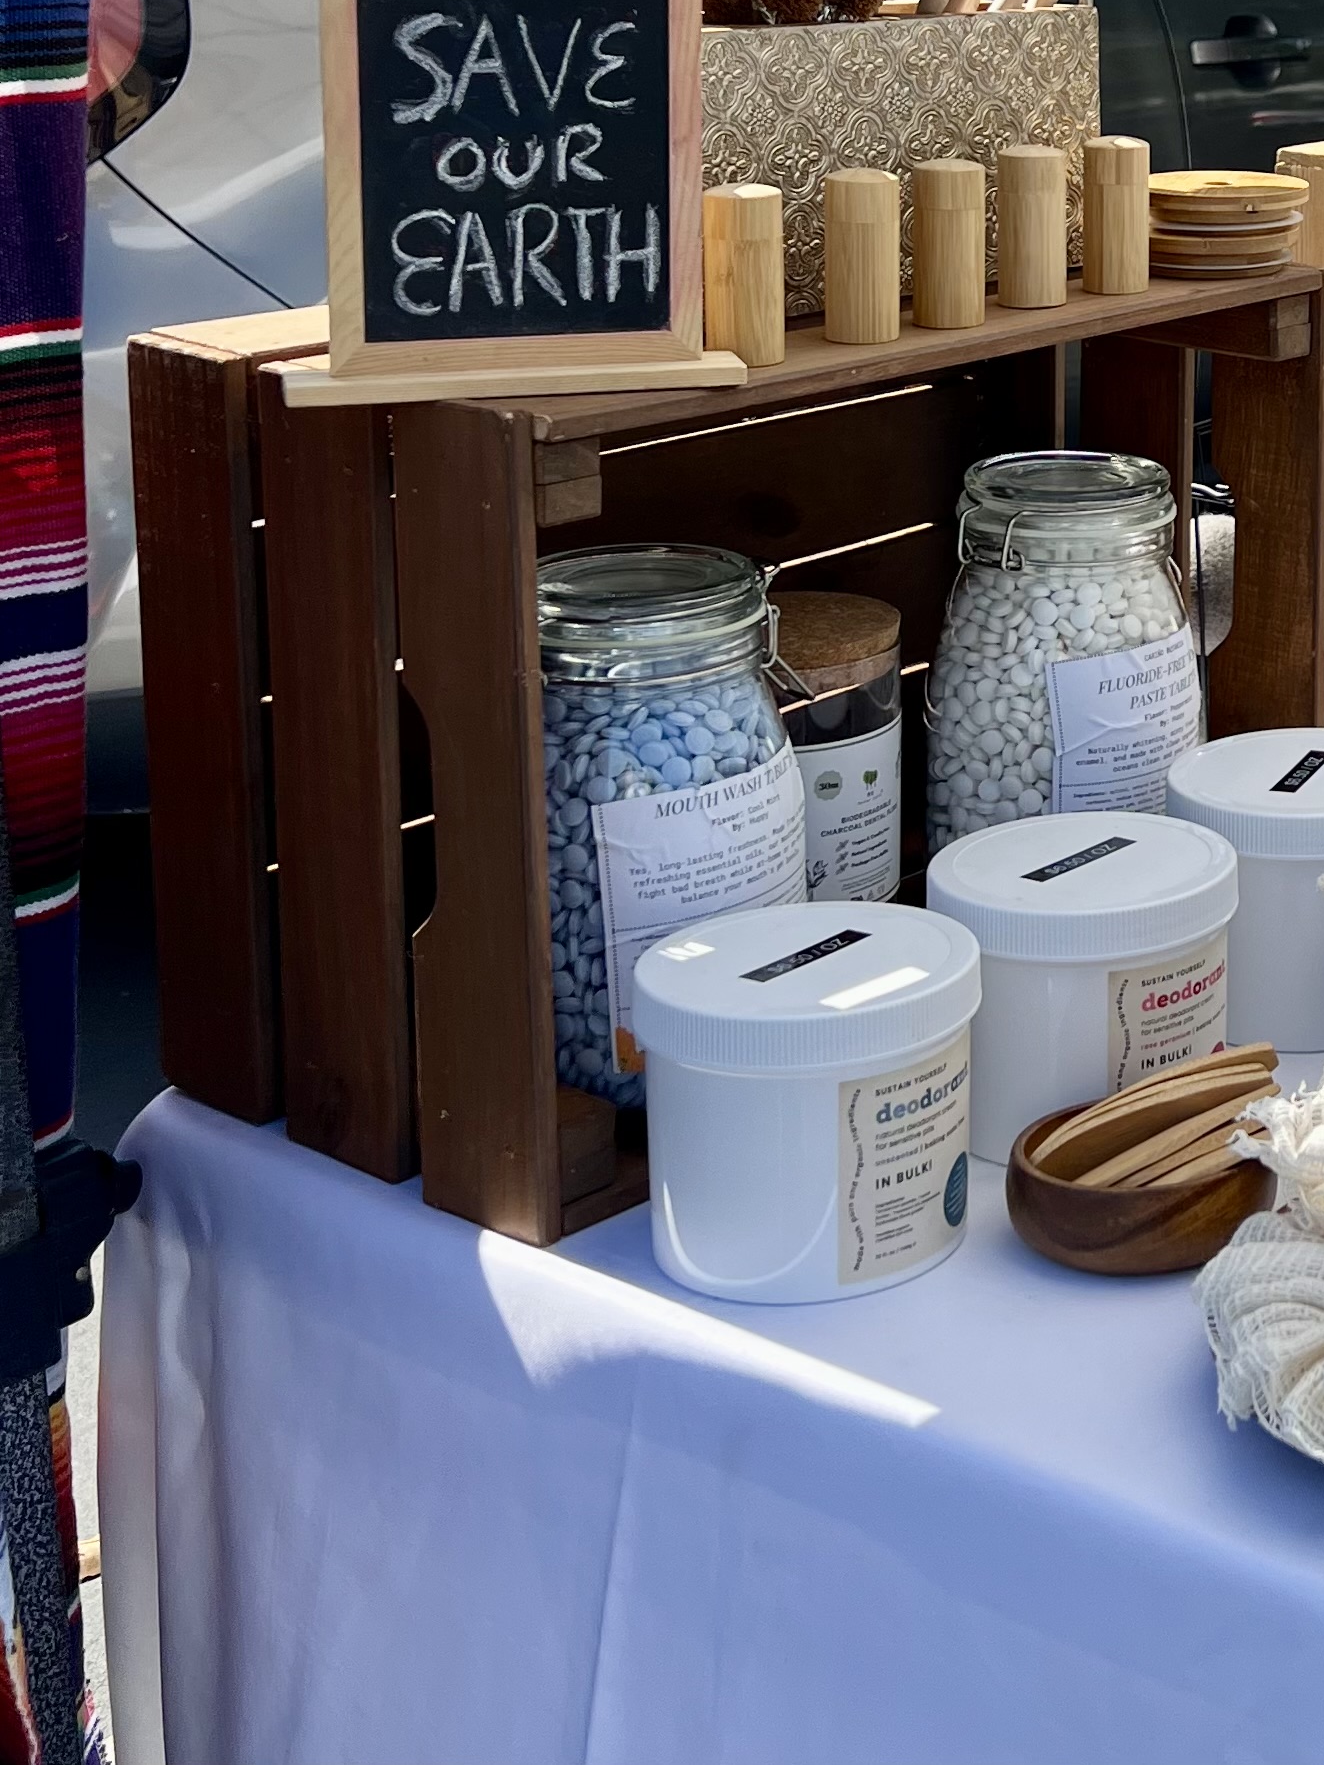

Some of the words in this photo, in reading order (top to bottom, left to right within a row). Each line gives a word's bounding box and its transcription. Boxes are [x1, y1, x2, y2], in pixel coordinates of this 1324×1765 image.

[390, 12, 637, 123] SAVE
[437, 123, 609, 191] OUR
[390, 203, 660, 317] EARTH
[1098, 655, 1186, 695] FLUORIDE-FREE
[1130, 687, 1166, 710] PASTE
[1303, 756, 1324, 767] OZ
[654, 791, 719, 819] MOUTH
[723, 773, 762, 801] WASH
[841, 798, 891, 824] BIODEGRADABLE
[820, 822, 863, 837] CHARCOAL
[1090, 843, 1117, 855] OZ
[633, 868, 691, 888] refreshing
[638, 887, 666, 899] fight
[671, 882, 689, 895] bad
[694, 872, 726, 889] breath
[820, 938, 850, 951] OZ
[1141, 973, 1174, 987] SUSTAIN
[1176, 959, 1206, 977] YOURSELF
[1141, 958, 1225, 1012] deodorant
[1141, 1058, 1155, 1070] IN
[875, 1080, 912, 1096] SUSTAIN
[876, 1060, 968, 1124] deodorant
[875, 1175, 891, 1190] IN
